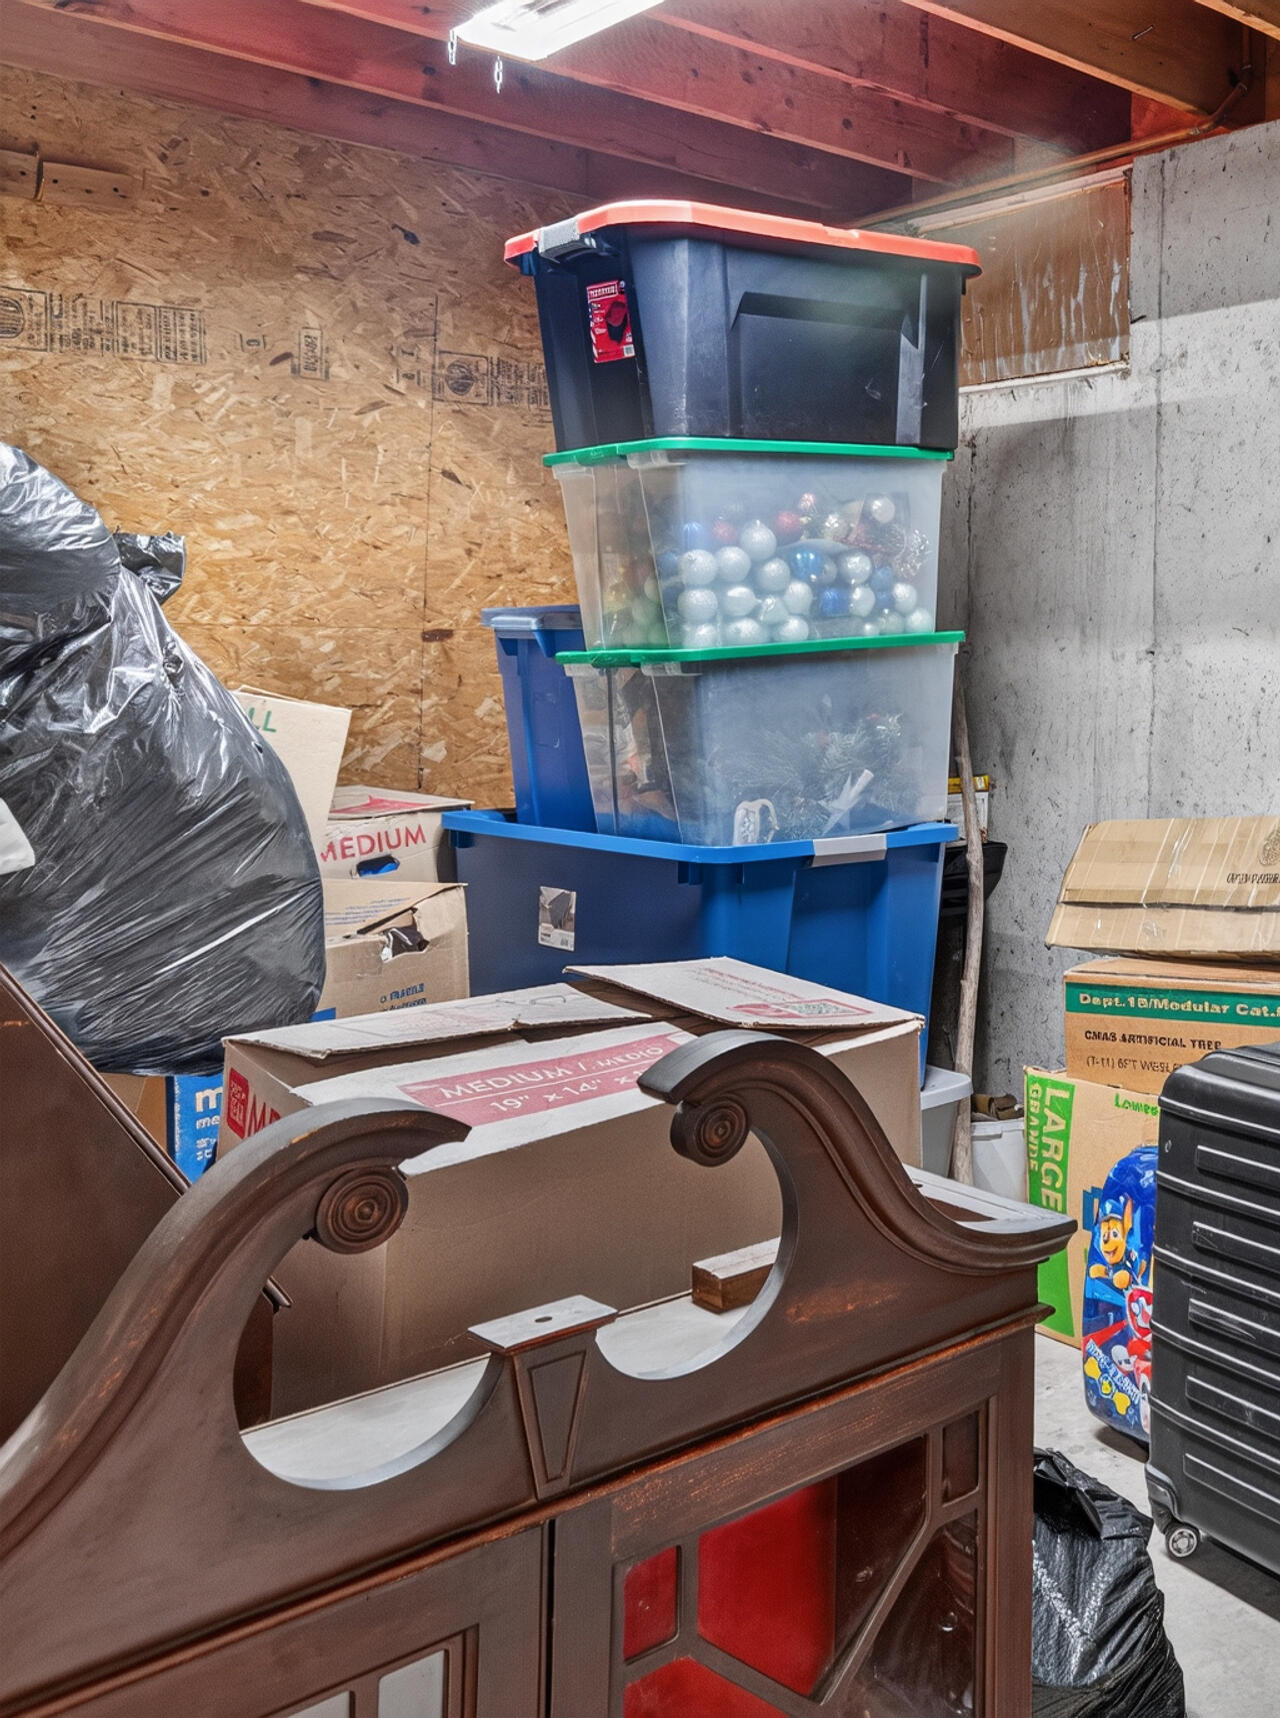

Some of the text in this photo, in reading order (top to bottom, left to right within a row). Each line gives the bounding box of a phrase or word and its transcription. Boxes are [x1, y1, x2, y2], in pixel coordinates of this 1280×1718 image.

[320, 824, 426, 863] MEDIUM
[1119, 1033, 1187, 1048] ARTIFICIAL
[1190, 1039, 1222, 1050] TREE
[440, 1066, 572, 1099] MEDIUM
[1040, 1086, 1071, 1213] LARGE
